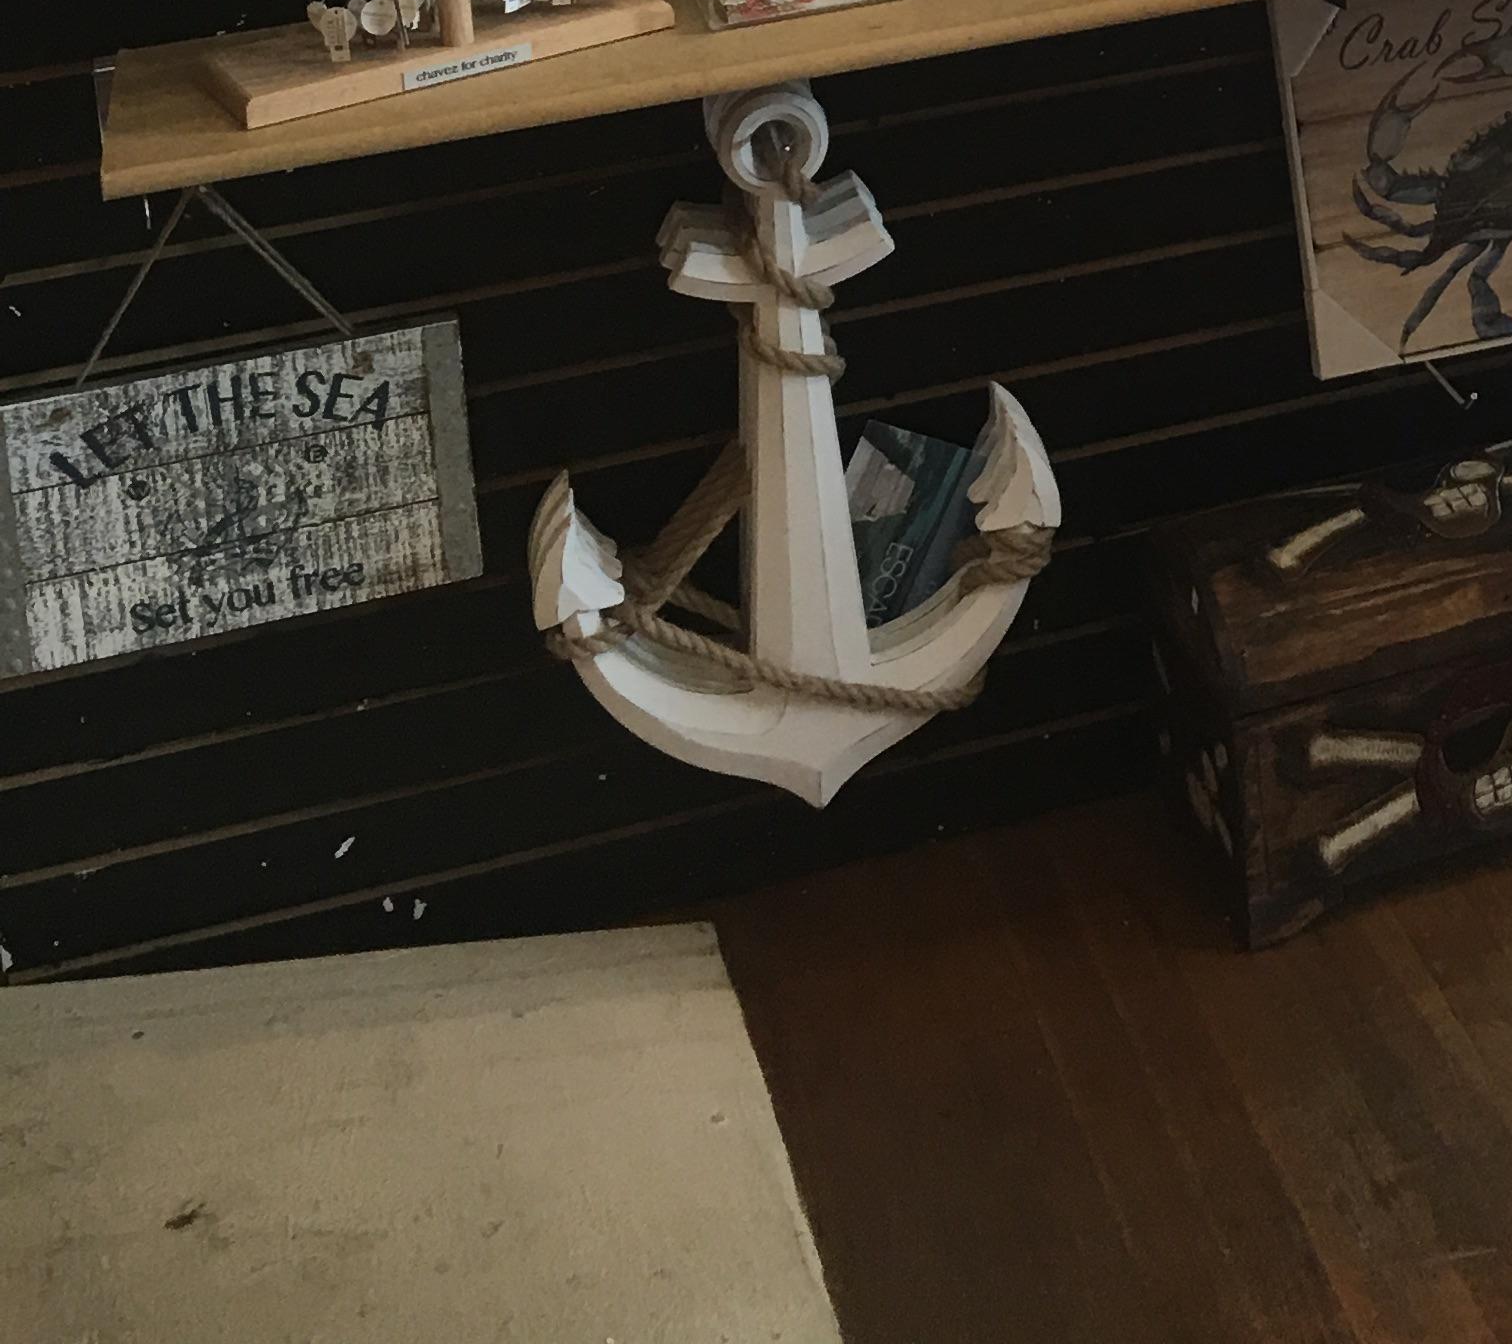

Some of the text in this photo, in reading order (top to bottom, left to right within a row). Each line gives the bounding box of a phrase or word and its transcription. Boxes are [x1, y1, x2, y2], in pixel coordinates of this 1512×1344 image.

[416, 50, 518, 82] chavez for charity
[1339, 8, 1453, 72] Crab
[49, 370, 391, 489] LET THE SEA
[202, 578, 277, 628] you
[289, 560, 366, 600] free
